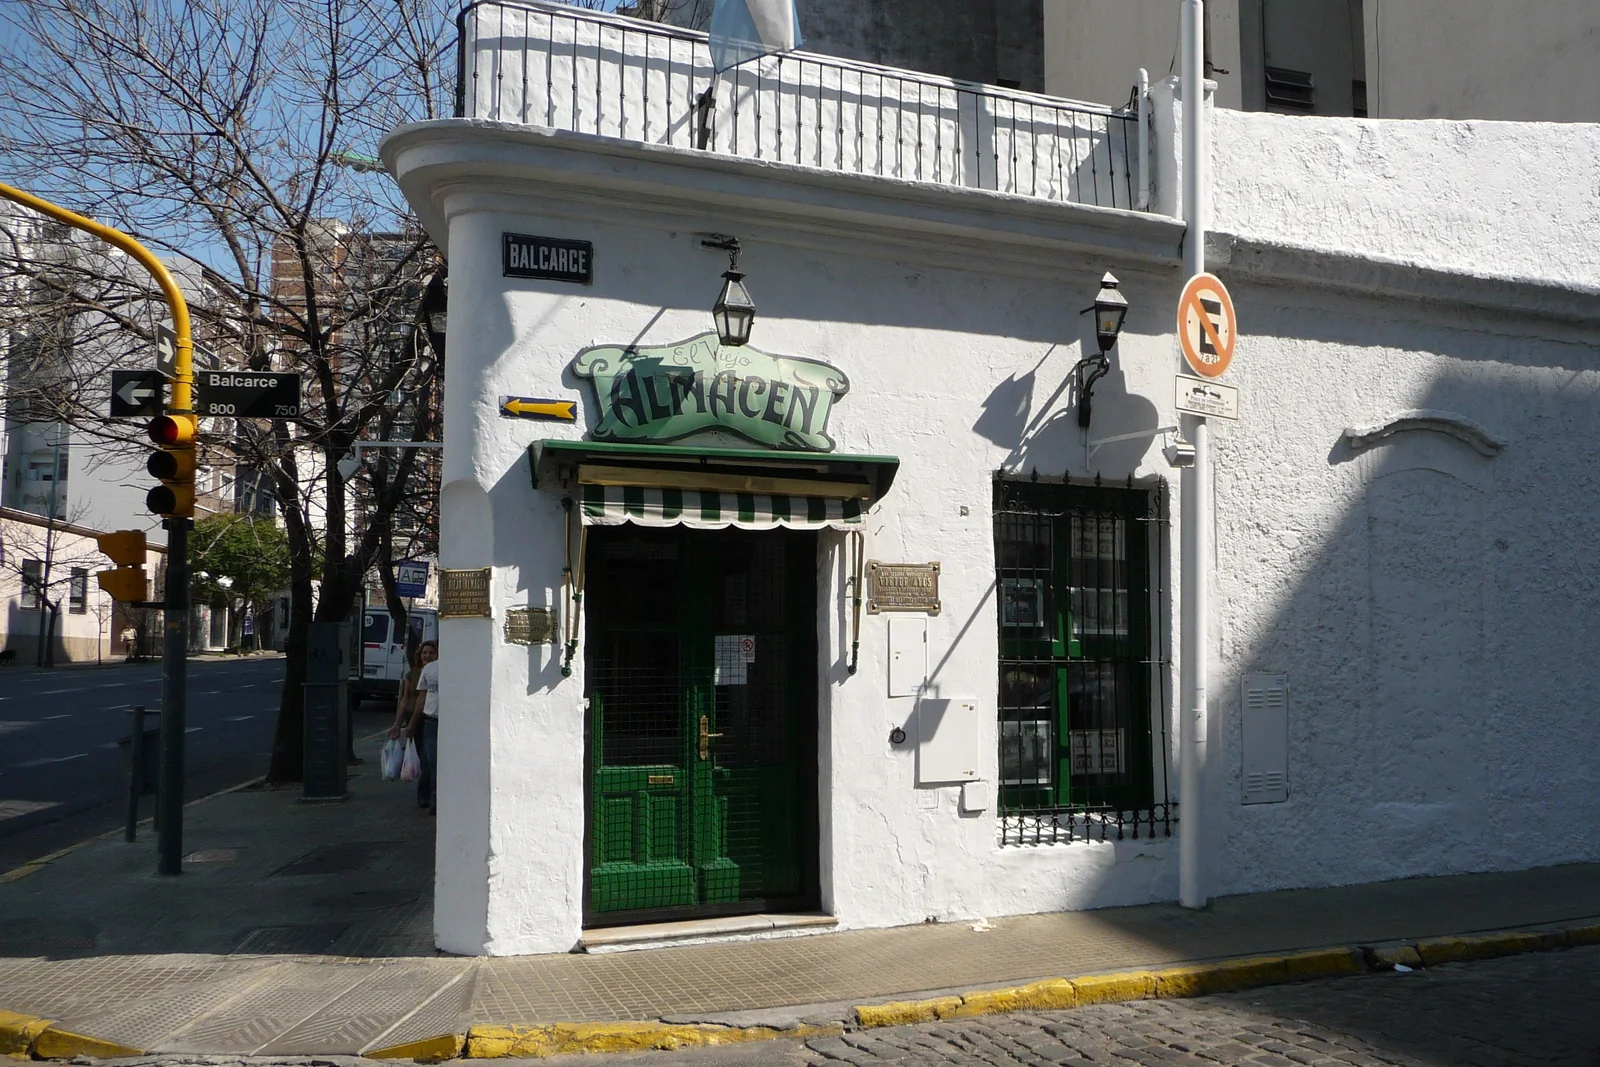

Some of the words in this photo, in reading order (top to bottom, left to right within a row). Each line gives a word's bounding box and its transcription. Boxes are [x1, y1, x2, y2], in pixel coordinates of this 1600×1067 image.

[510, 243, 587, 274] BALCARCE
[673, 343, 701, 366] El
[699, 339, 754, 369] Viejo
[1205, 354, 1210, 363] a
[1211, 355, 1218, 364] 21
[209, 374, 278, 388] Balcarce
[609, 368, 820, 435] ALMACEN
[209, 403, 236, 415] 800
[274, 404, 298, 416] 750
[400, 568, 411, 582] A
[878, 576, 909, 587] VICTOR
